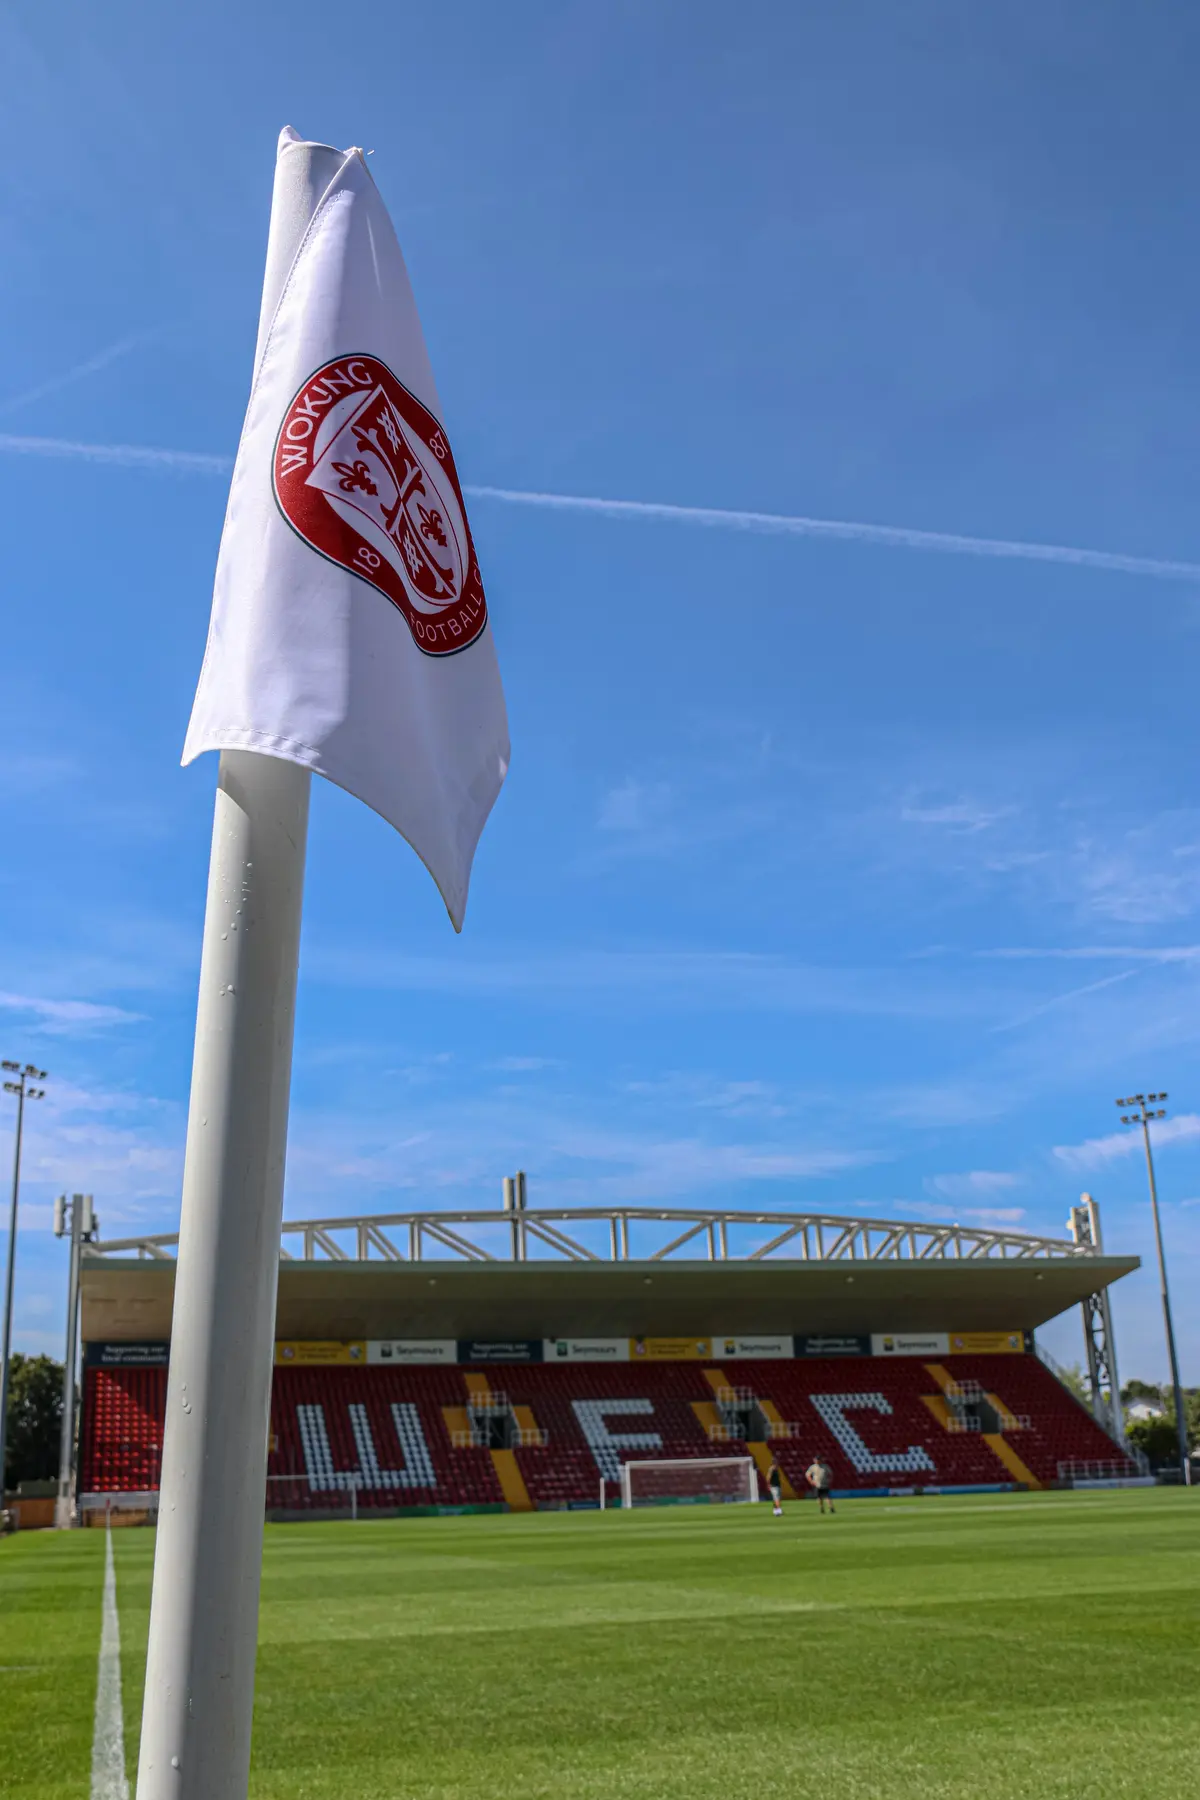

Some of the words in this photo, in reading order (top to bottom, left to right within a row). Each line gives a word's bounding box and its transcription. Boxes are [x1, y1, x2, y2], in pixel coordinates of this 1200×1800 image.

[280, 361, 373, 478] WOKING
[429, 430, 449, 459] 87
[352, 547, 381, 575] 18
[409, 592, 482, 642] FOOTBALL
[396, 1345, 444, 1356] Seymours
[572, 1344, 617, 1355] Seymours
[571, 1398, 662, 1482] F
[809, 1392, 936, 1473] C
